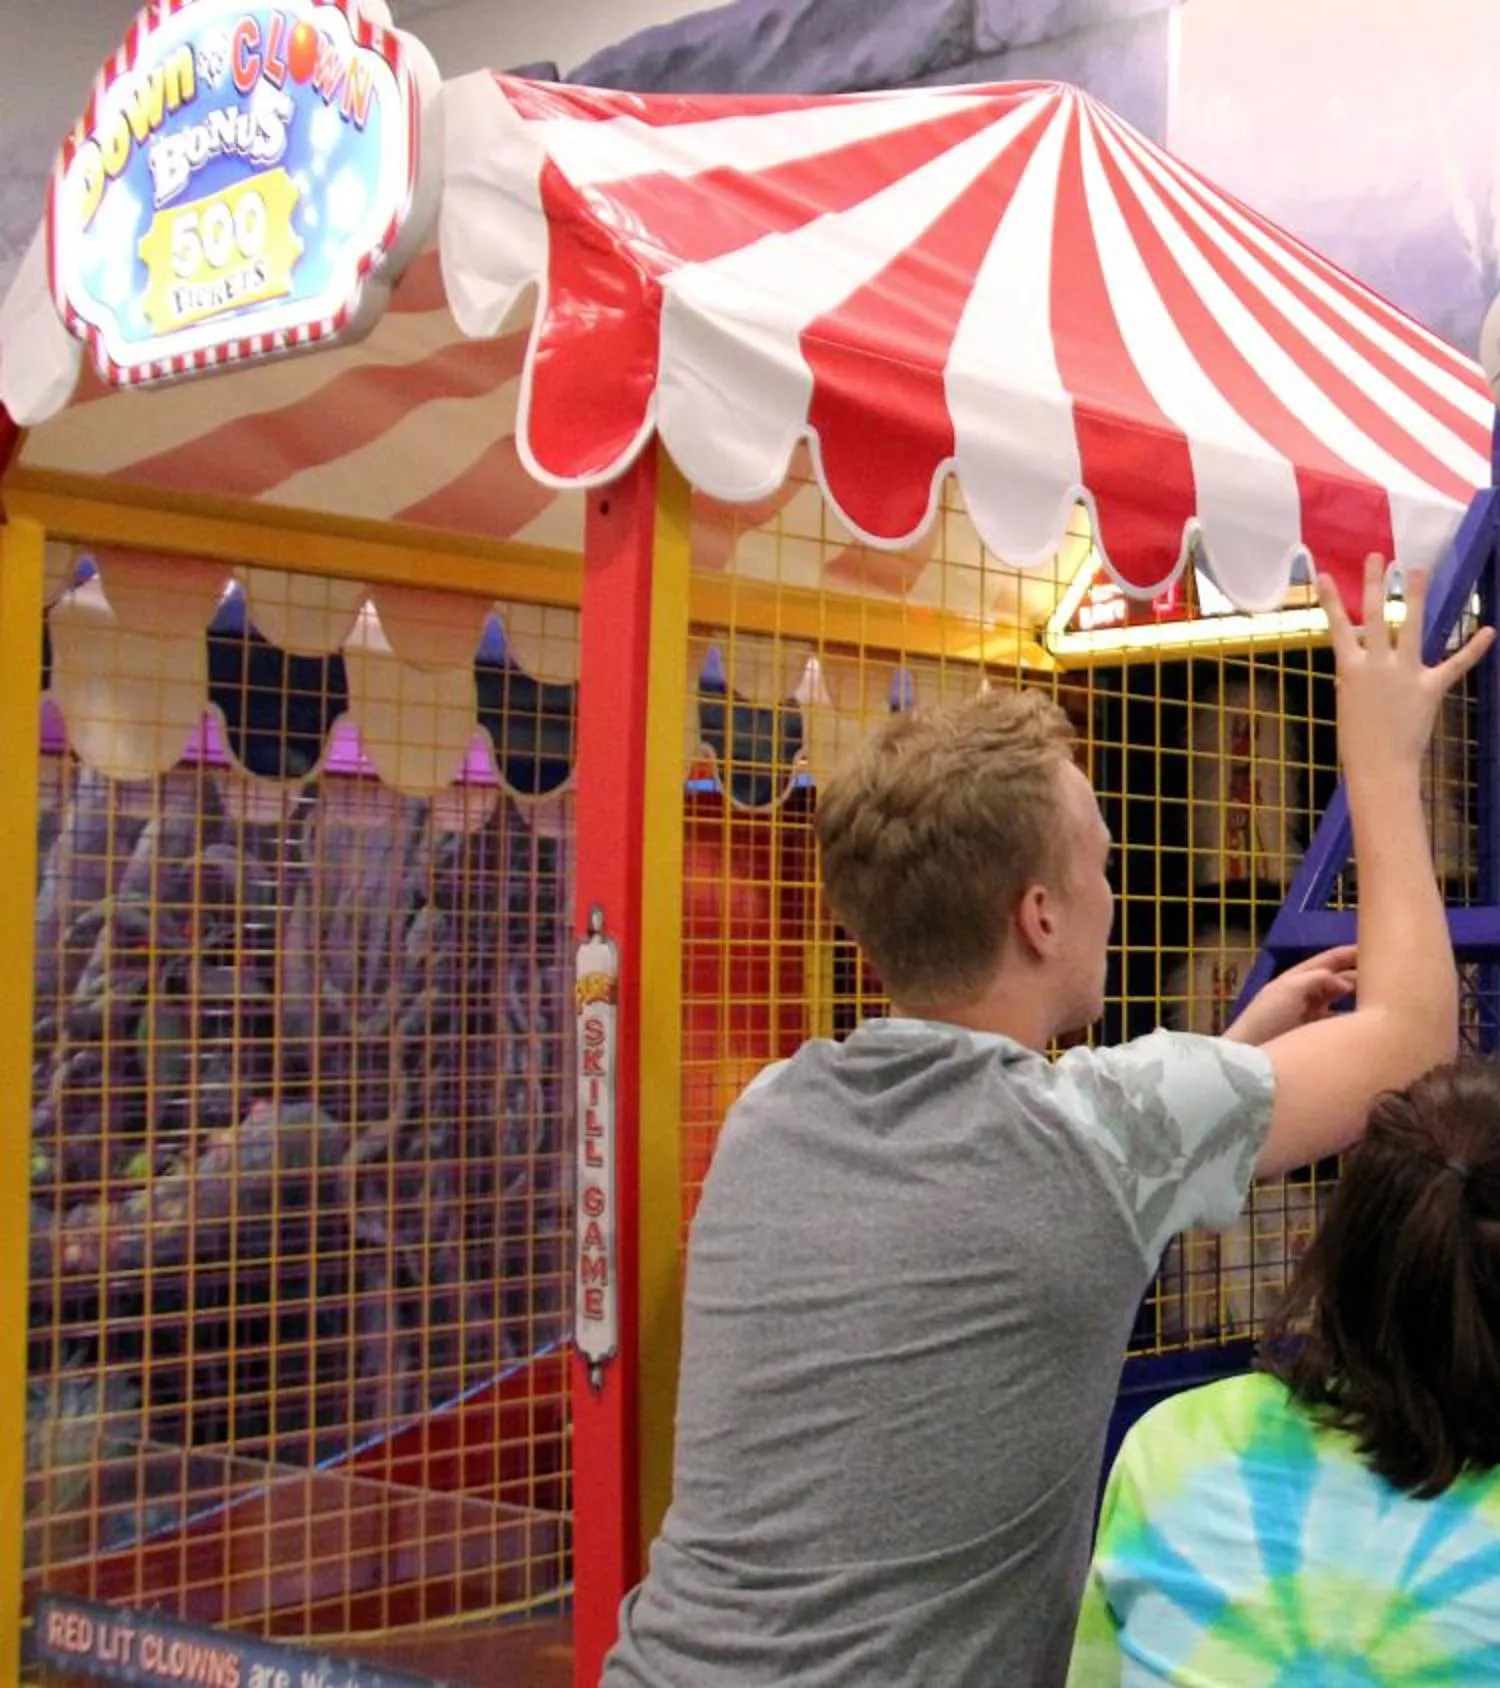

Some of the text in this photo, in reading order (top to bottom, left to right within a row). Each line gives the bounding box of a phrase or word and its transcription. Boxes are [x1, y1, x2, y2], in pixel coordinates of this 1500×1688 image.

[171, 189, 266, 278] 500
[583, 1018, 606, 1170] SKILL
[580, 1187, 608, 1322] GAME
[48, 1611, 93, 1651] RED
[98, 1624, 135, 1665] LIT
[141, 1634, 241, 1688] CLOWNS
